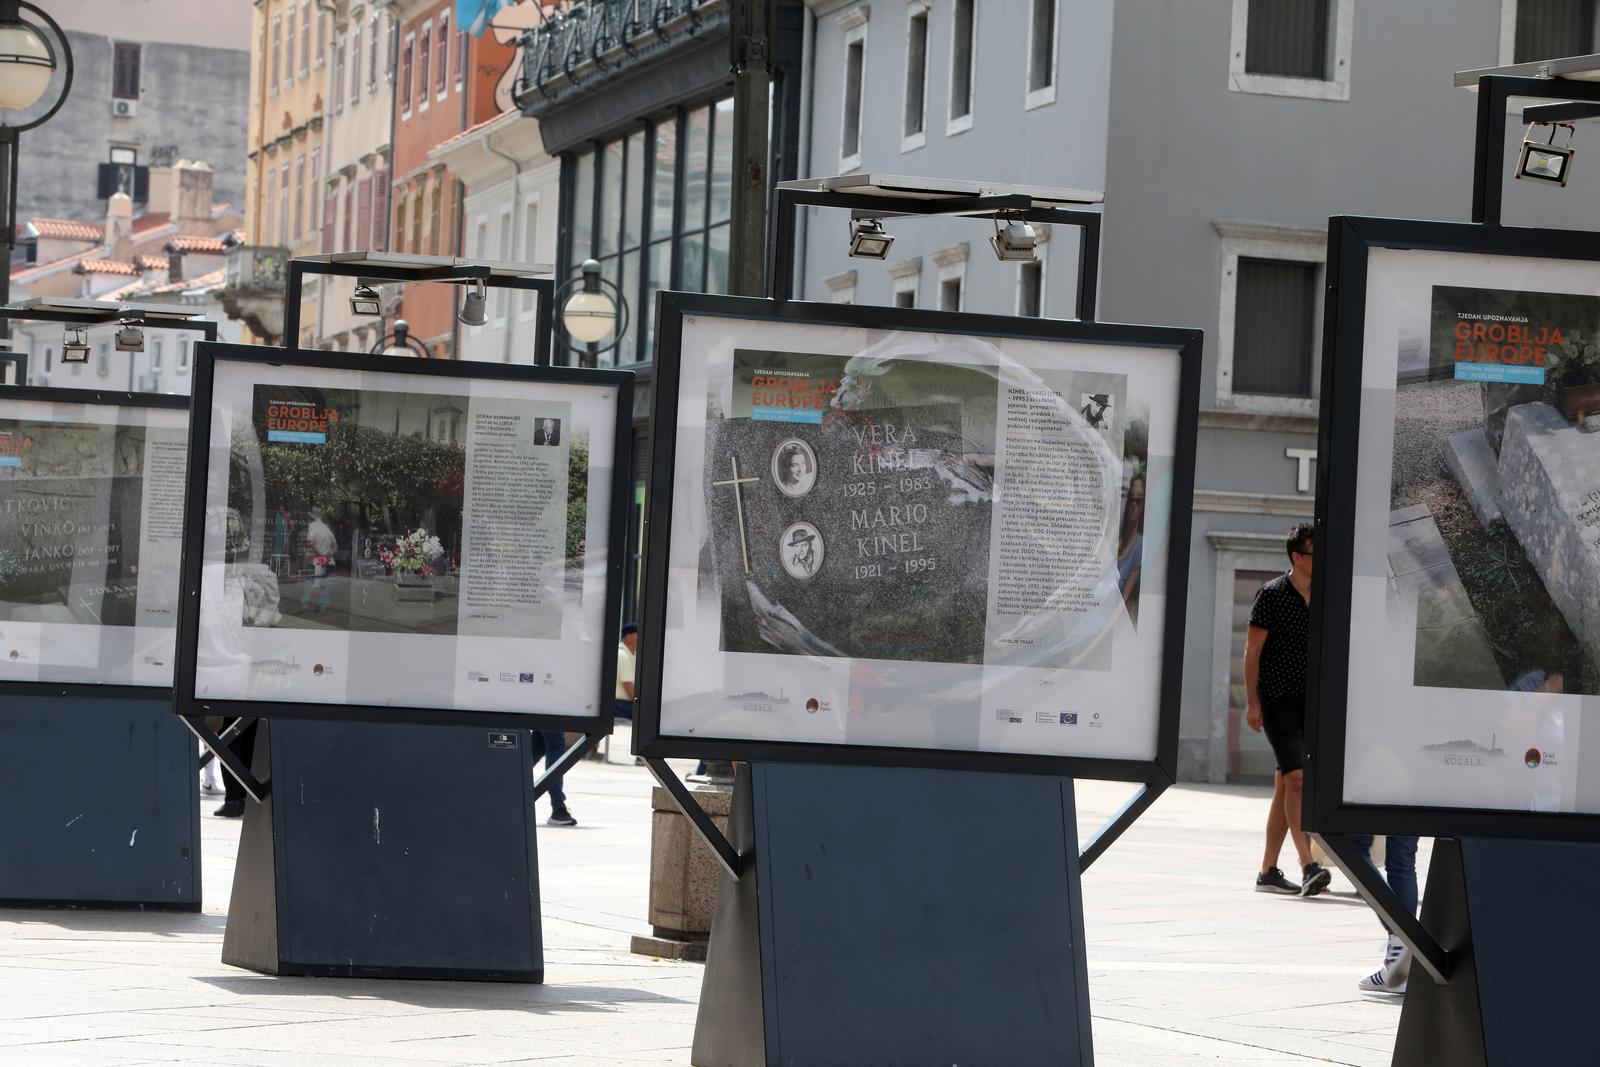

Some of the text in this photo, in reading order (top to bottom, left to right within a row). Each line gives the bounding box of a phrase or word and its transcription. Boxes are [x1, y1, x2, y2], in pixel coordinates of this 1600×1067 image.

[1482, 315, 1529, 323] UPOZNAVANJA
[1455, 321, 1565, 346] GROBLJA
[1455, 341, 1547, 366] EUROPE
[752, 376, 837, 394] GROBLJA
[752, 392, 825, 410] EUROPE
[267, 405, 338, 422] GROBLJA
[268, 417, 328, 432] EUROPE
[851, 423, 918, 447] VERA
[852, 449, 922, 476] KINEL
[843, 482, 876, 497] 1925
[900, 478, 932, 492] 1983
[851, 504, 926, 530] MARIO
[21, 520, 76, 537] VINKO
[24, 544, 74, 561] JANKO
[857, 532, 924, 558] KINEL
[855, 564, 882, 580] 1921
[904, 558, 936, 573] 1995
[742, 704, 773, 712] KOZALA
[1444, 758, 1482, 766] KOZALA
